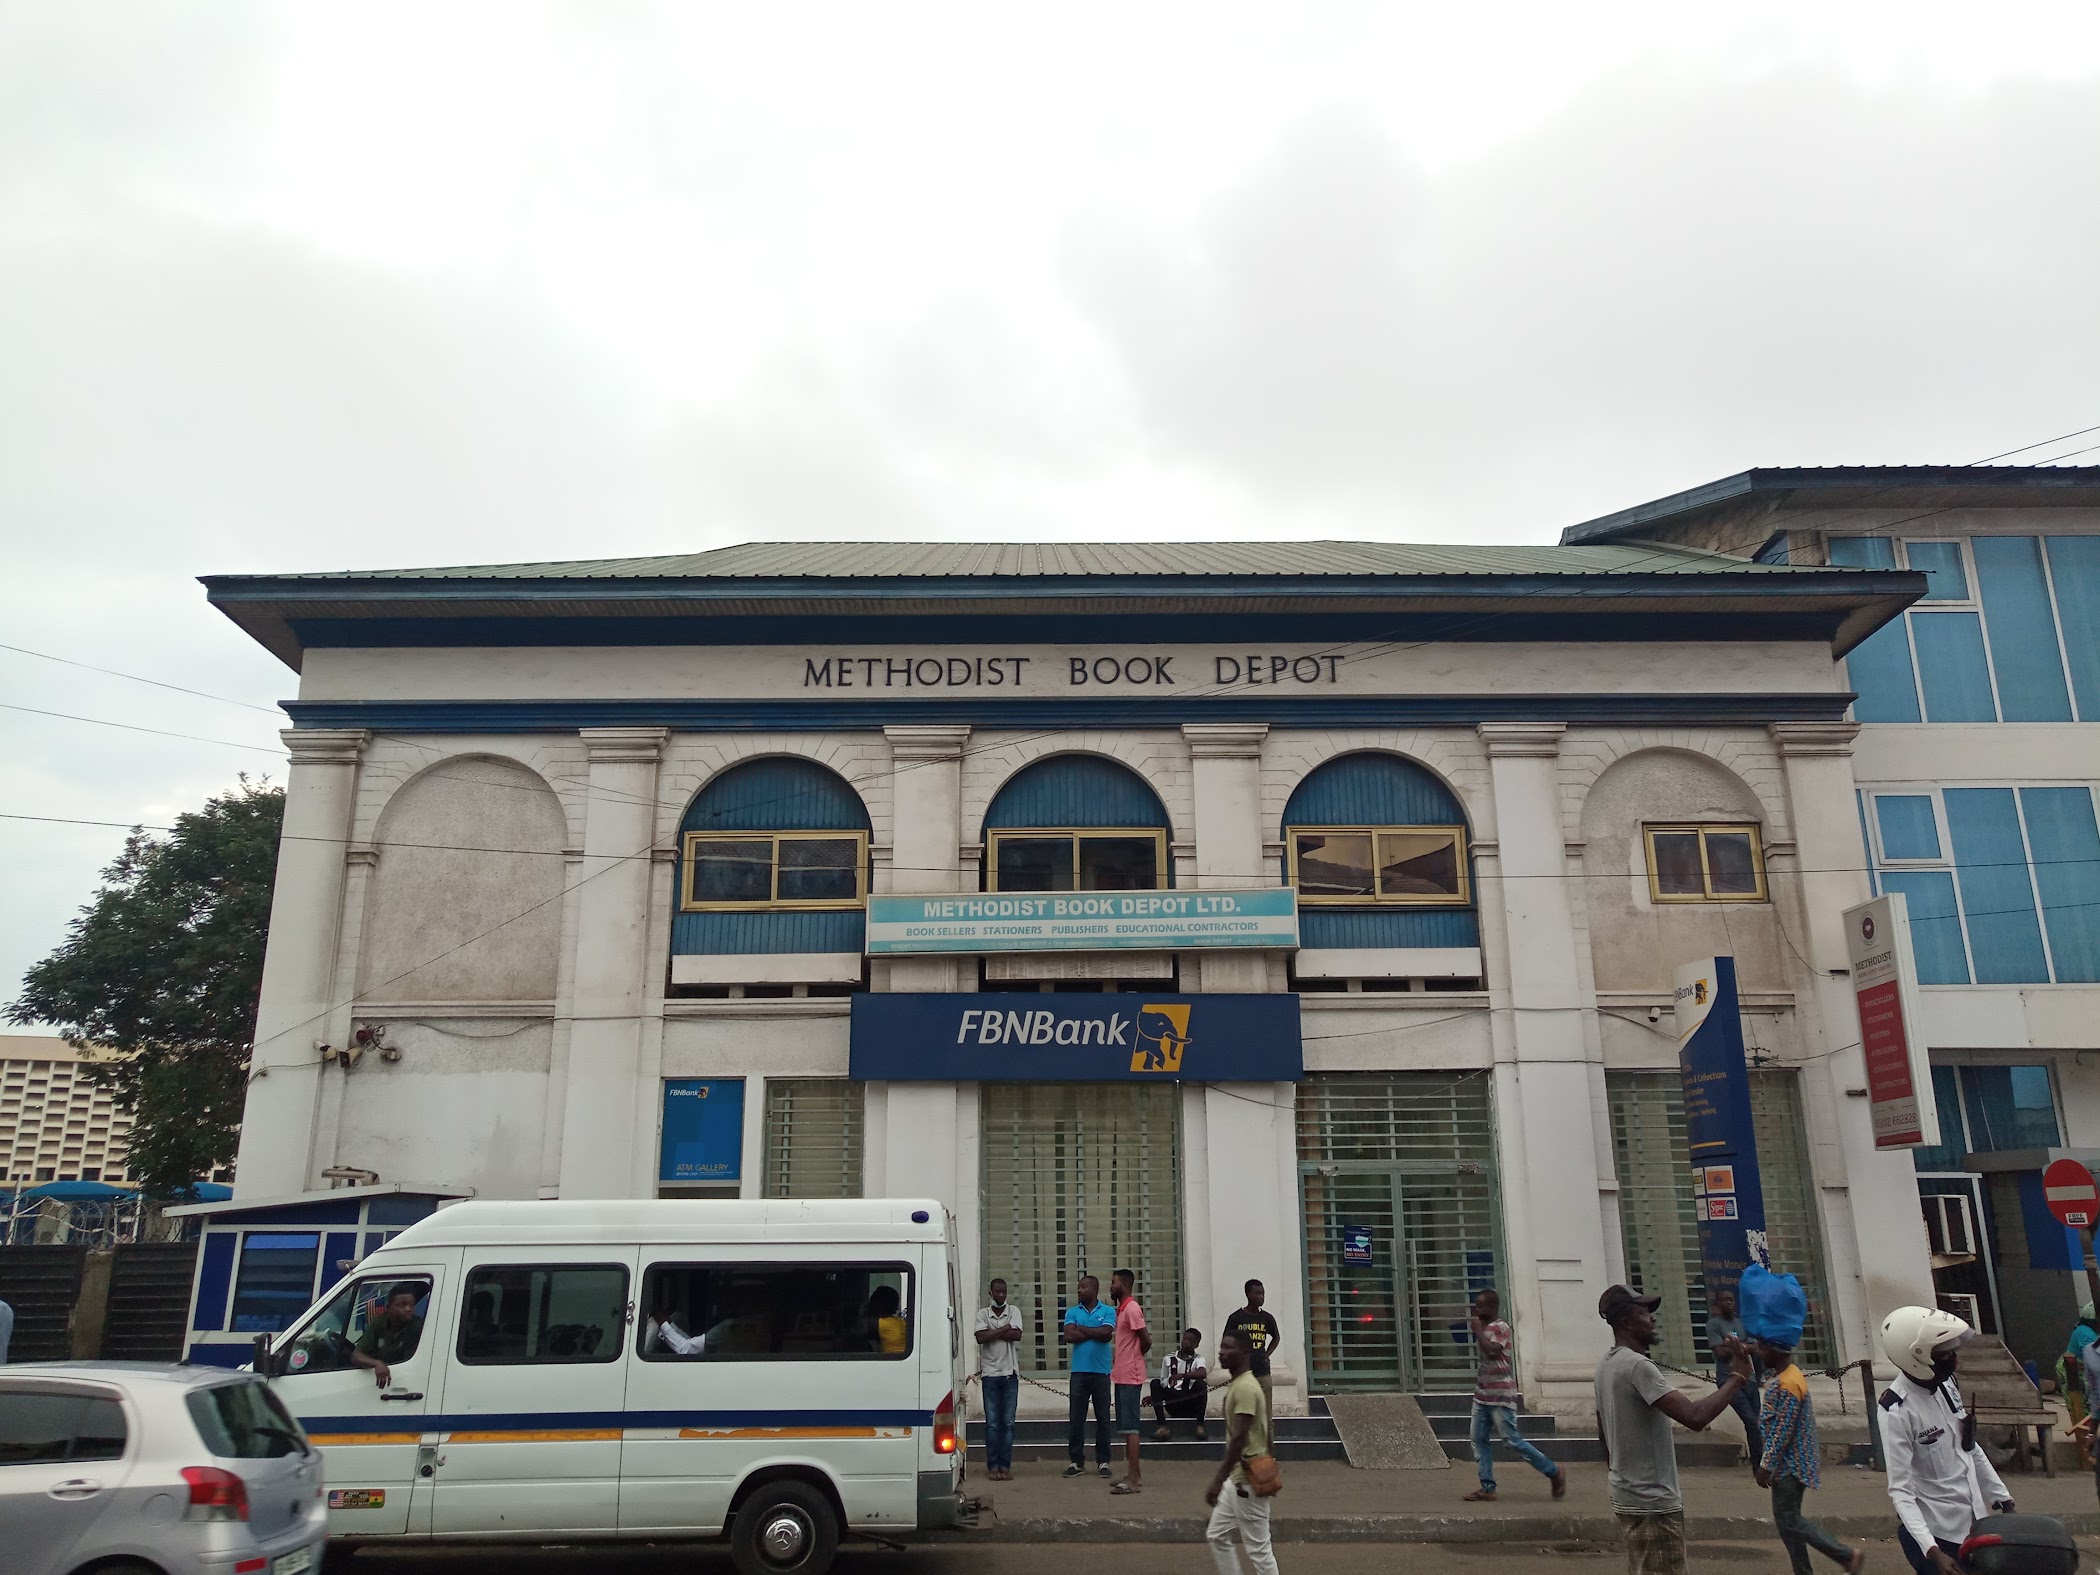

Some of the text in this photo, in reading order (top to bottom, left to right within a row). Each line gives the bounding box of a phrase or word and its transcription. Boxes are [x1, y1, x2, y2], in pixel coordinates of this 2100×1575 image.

[803, 655, 1345, 688] METHODIST BOOK DEPOT
[923, 896, 1242, 918] METHODIST BOOK DEPOT LTD.
[906, 921, 1259, 937] BOOK SELLERS STATIONERS PUBLISHERS EDUCATIONAL CONTRACTORS
[1855, 951, 1893, 972] METHODIST
[957, 1010, 1130, 1046] FBNBank
[1697, 1071, 1728, 1082] Collections
[669, 1089, 699, 1097] FBNBank
[676, 1163, 728, 1172] ATM GALLERY
